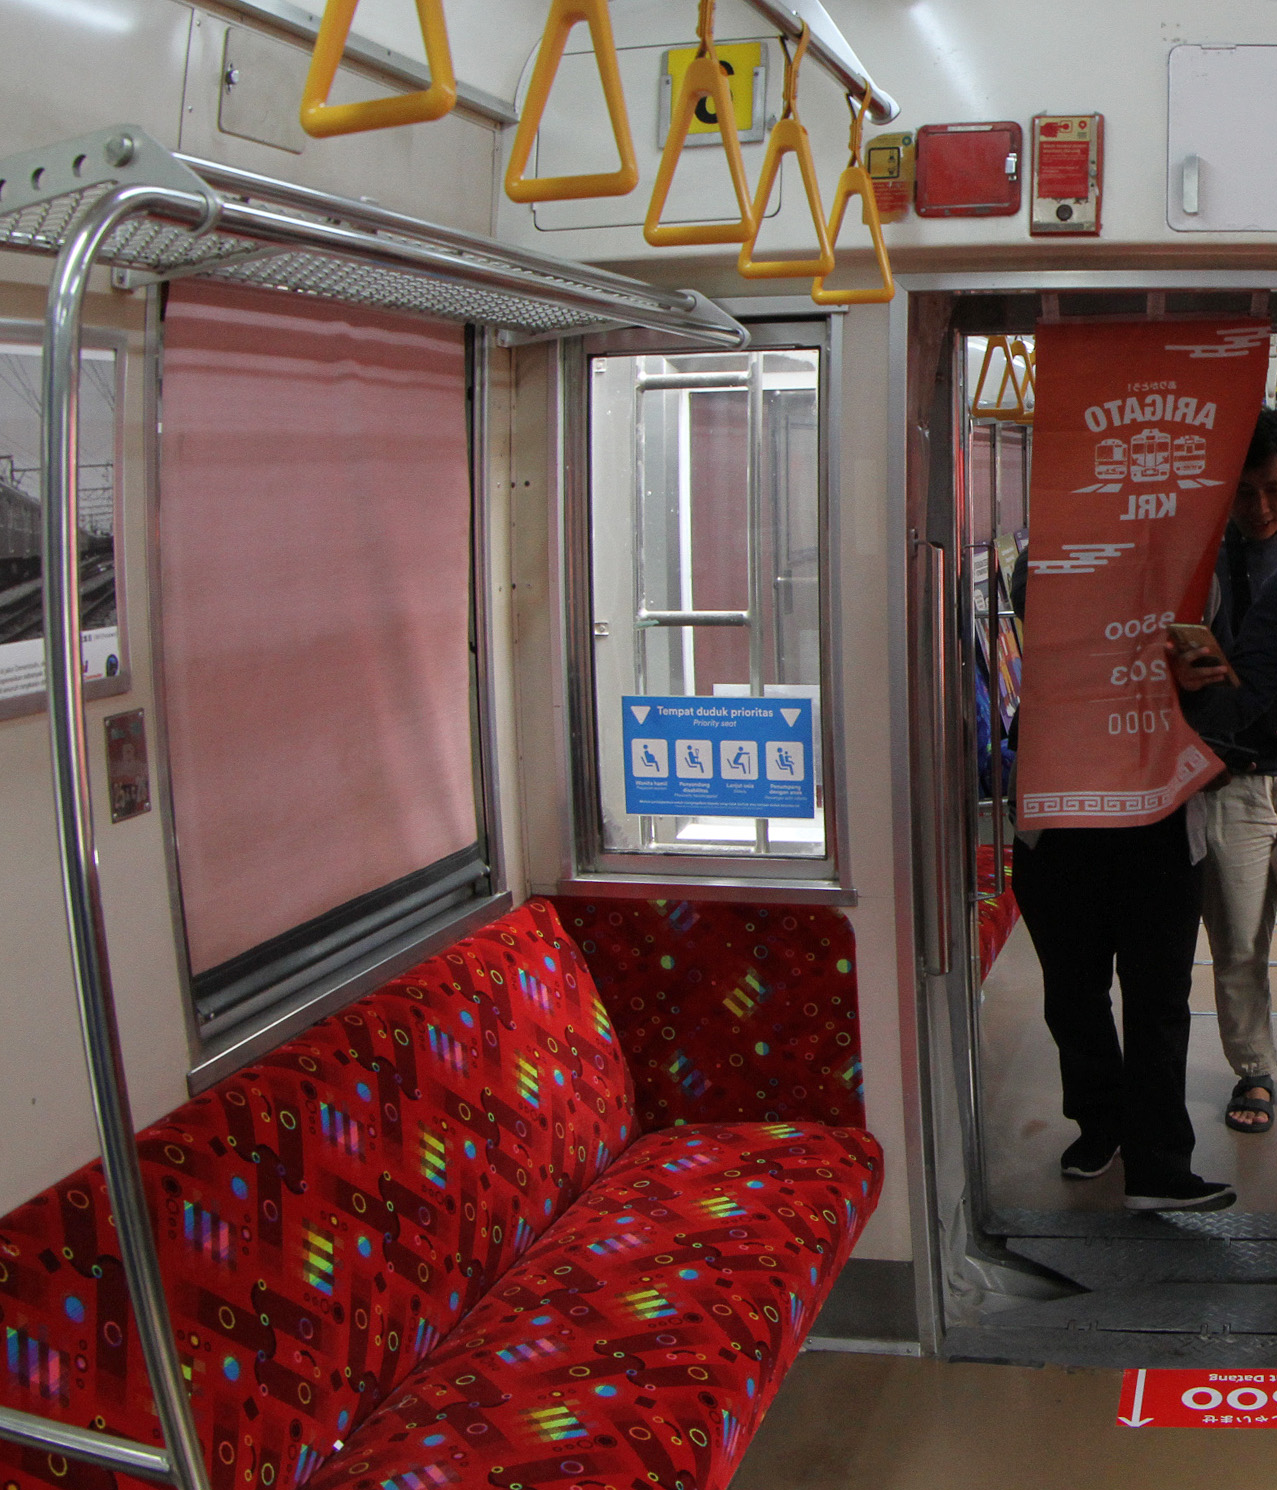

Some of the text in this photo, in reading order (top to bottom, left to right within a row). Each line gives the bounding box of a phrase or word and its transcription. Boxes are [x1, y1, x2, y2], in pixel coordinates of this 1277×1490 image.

[657, 706, 774, 719] Tempat duduk prioritas
[693, 719, 737, 728] Priority seat
[1209, 1374, 1266, 1382] Datang
